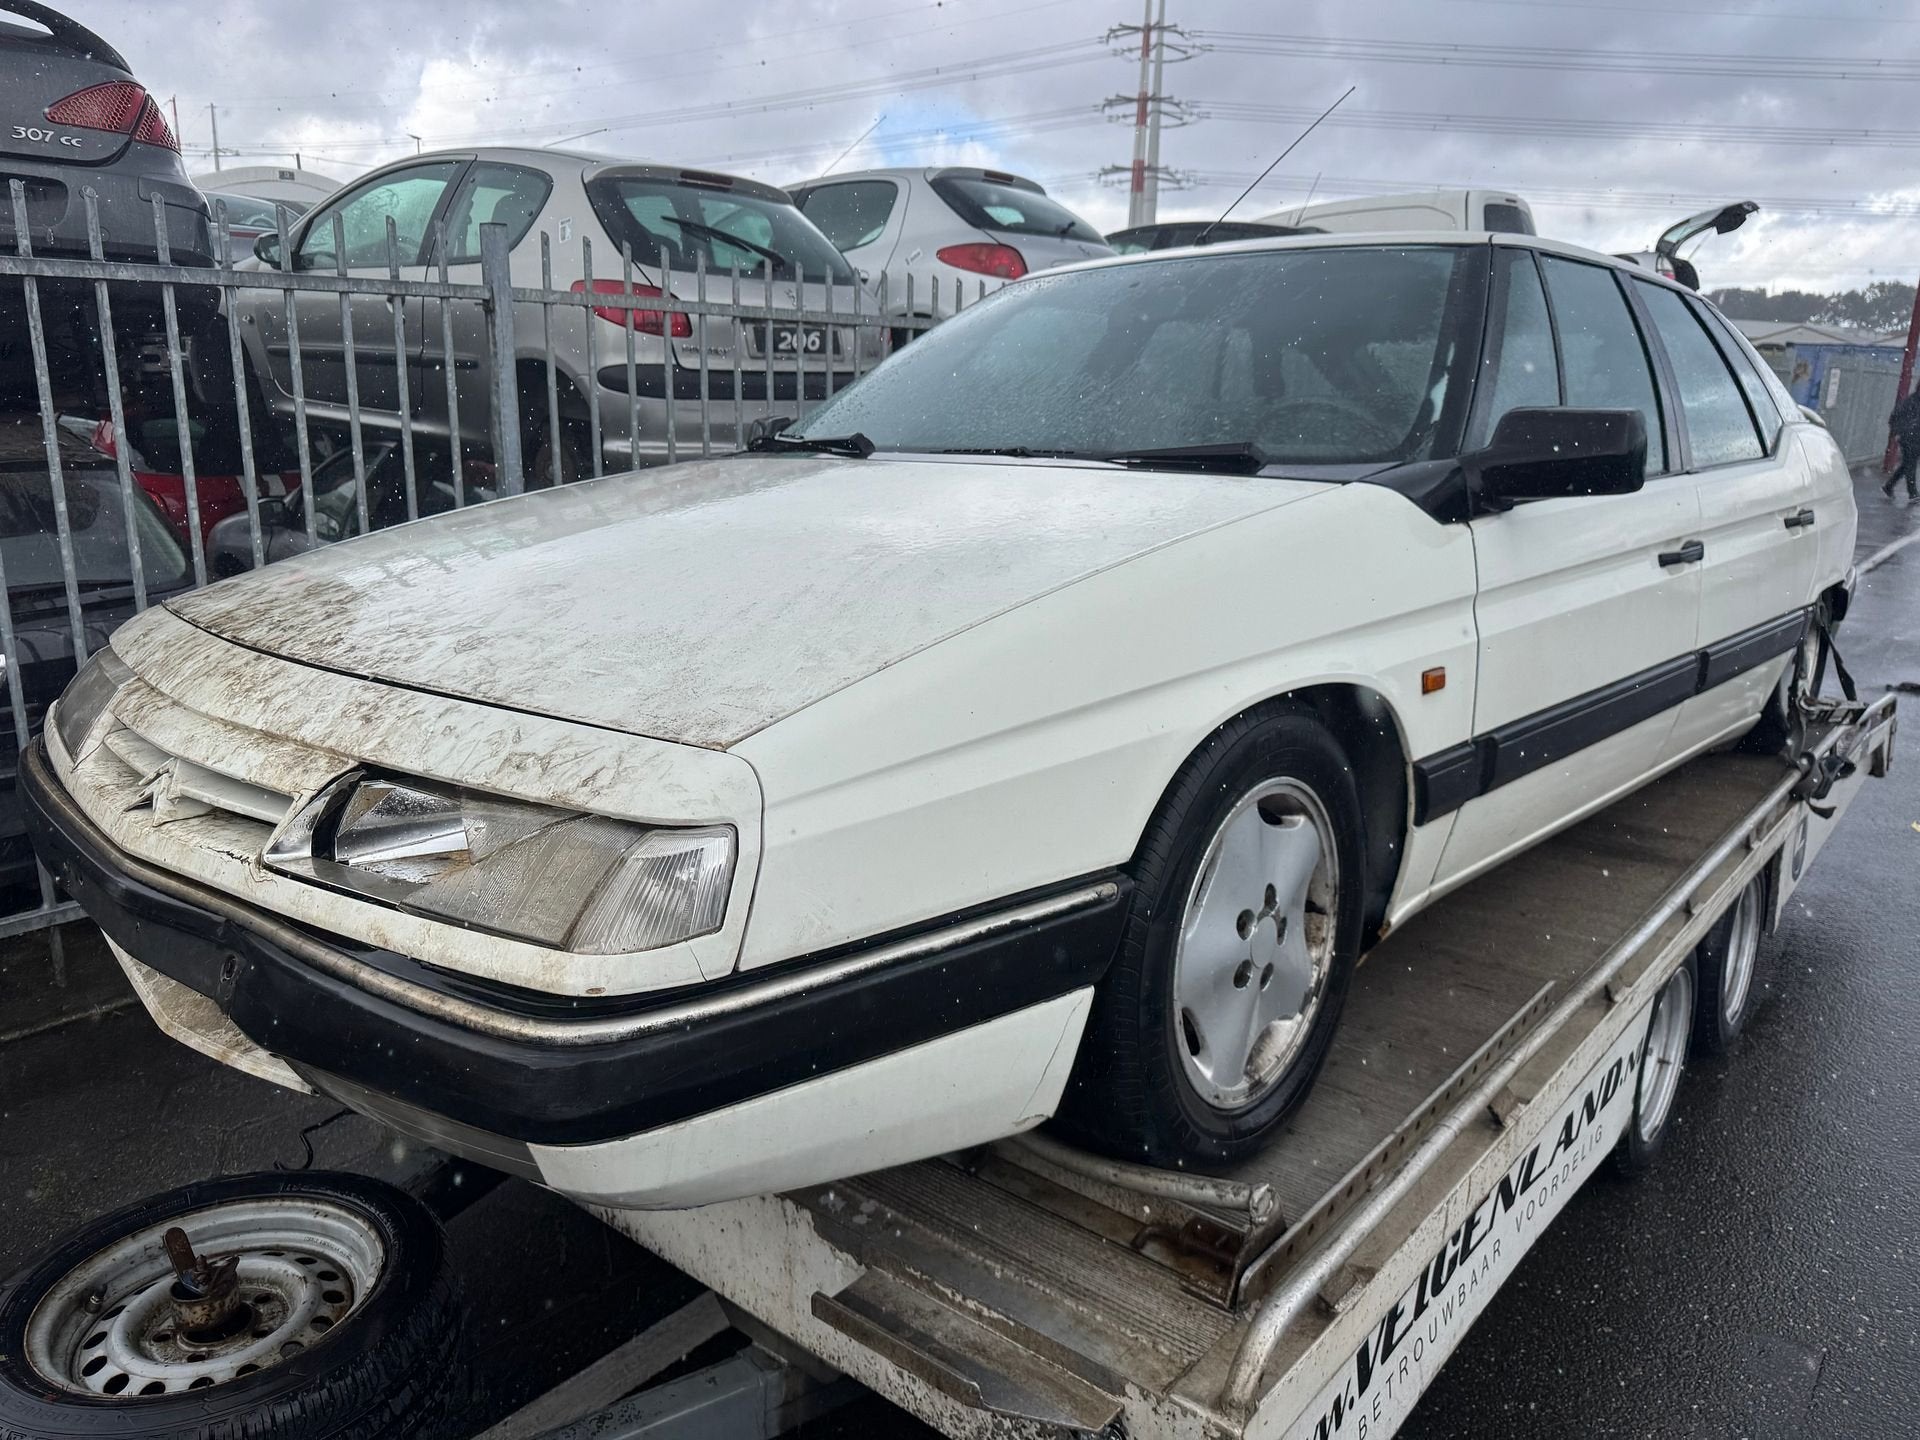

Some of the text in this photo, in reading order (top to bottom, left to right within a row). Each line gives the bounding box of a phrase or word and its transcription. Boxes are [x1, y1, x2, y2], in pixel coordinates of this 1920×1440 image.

[11, 125, 55, 143] 307
[778, 331, 821, 351] 206
[1358, 1124, 1603, 1440] BETROUWBAAR VOORDELIG
